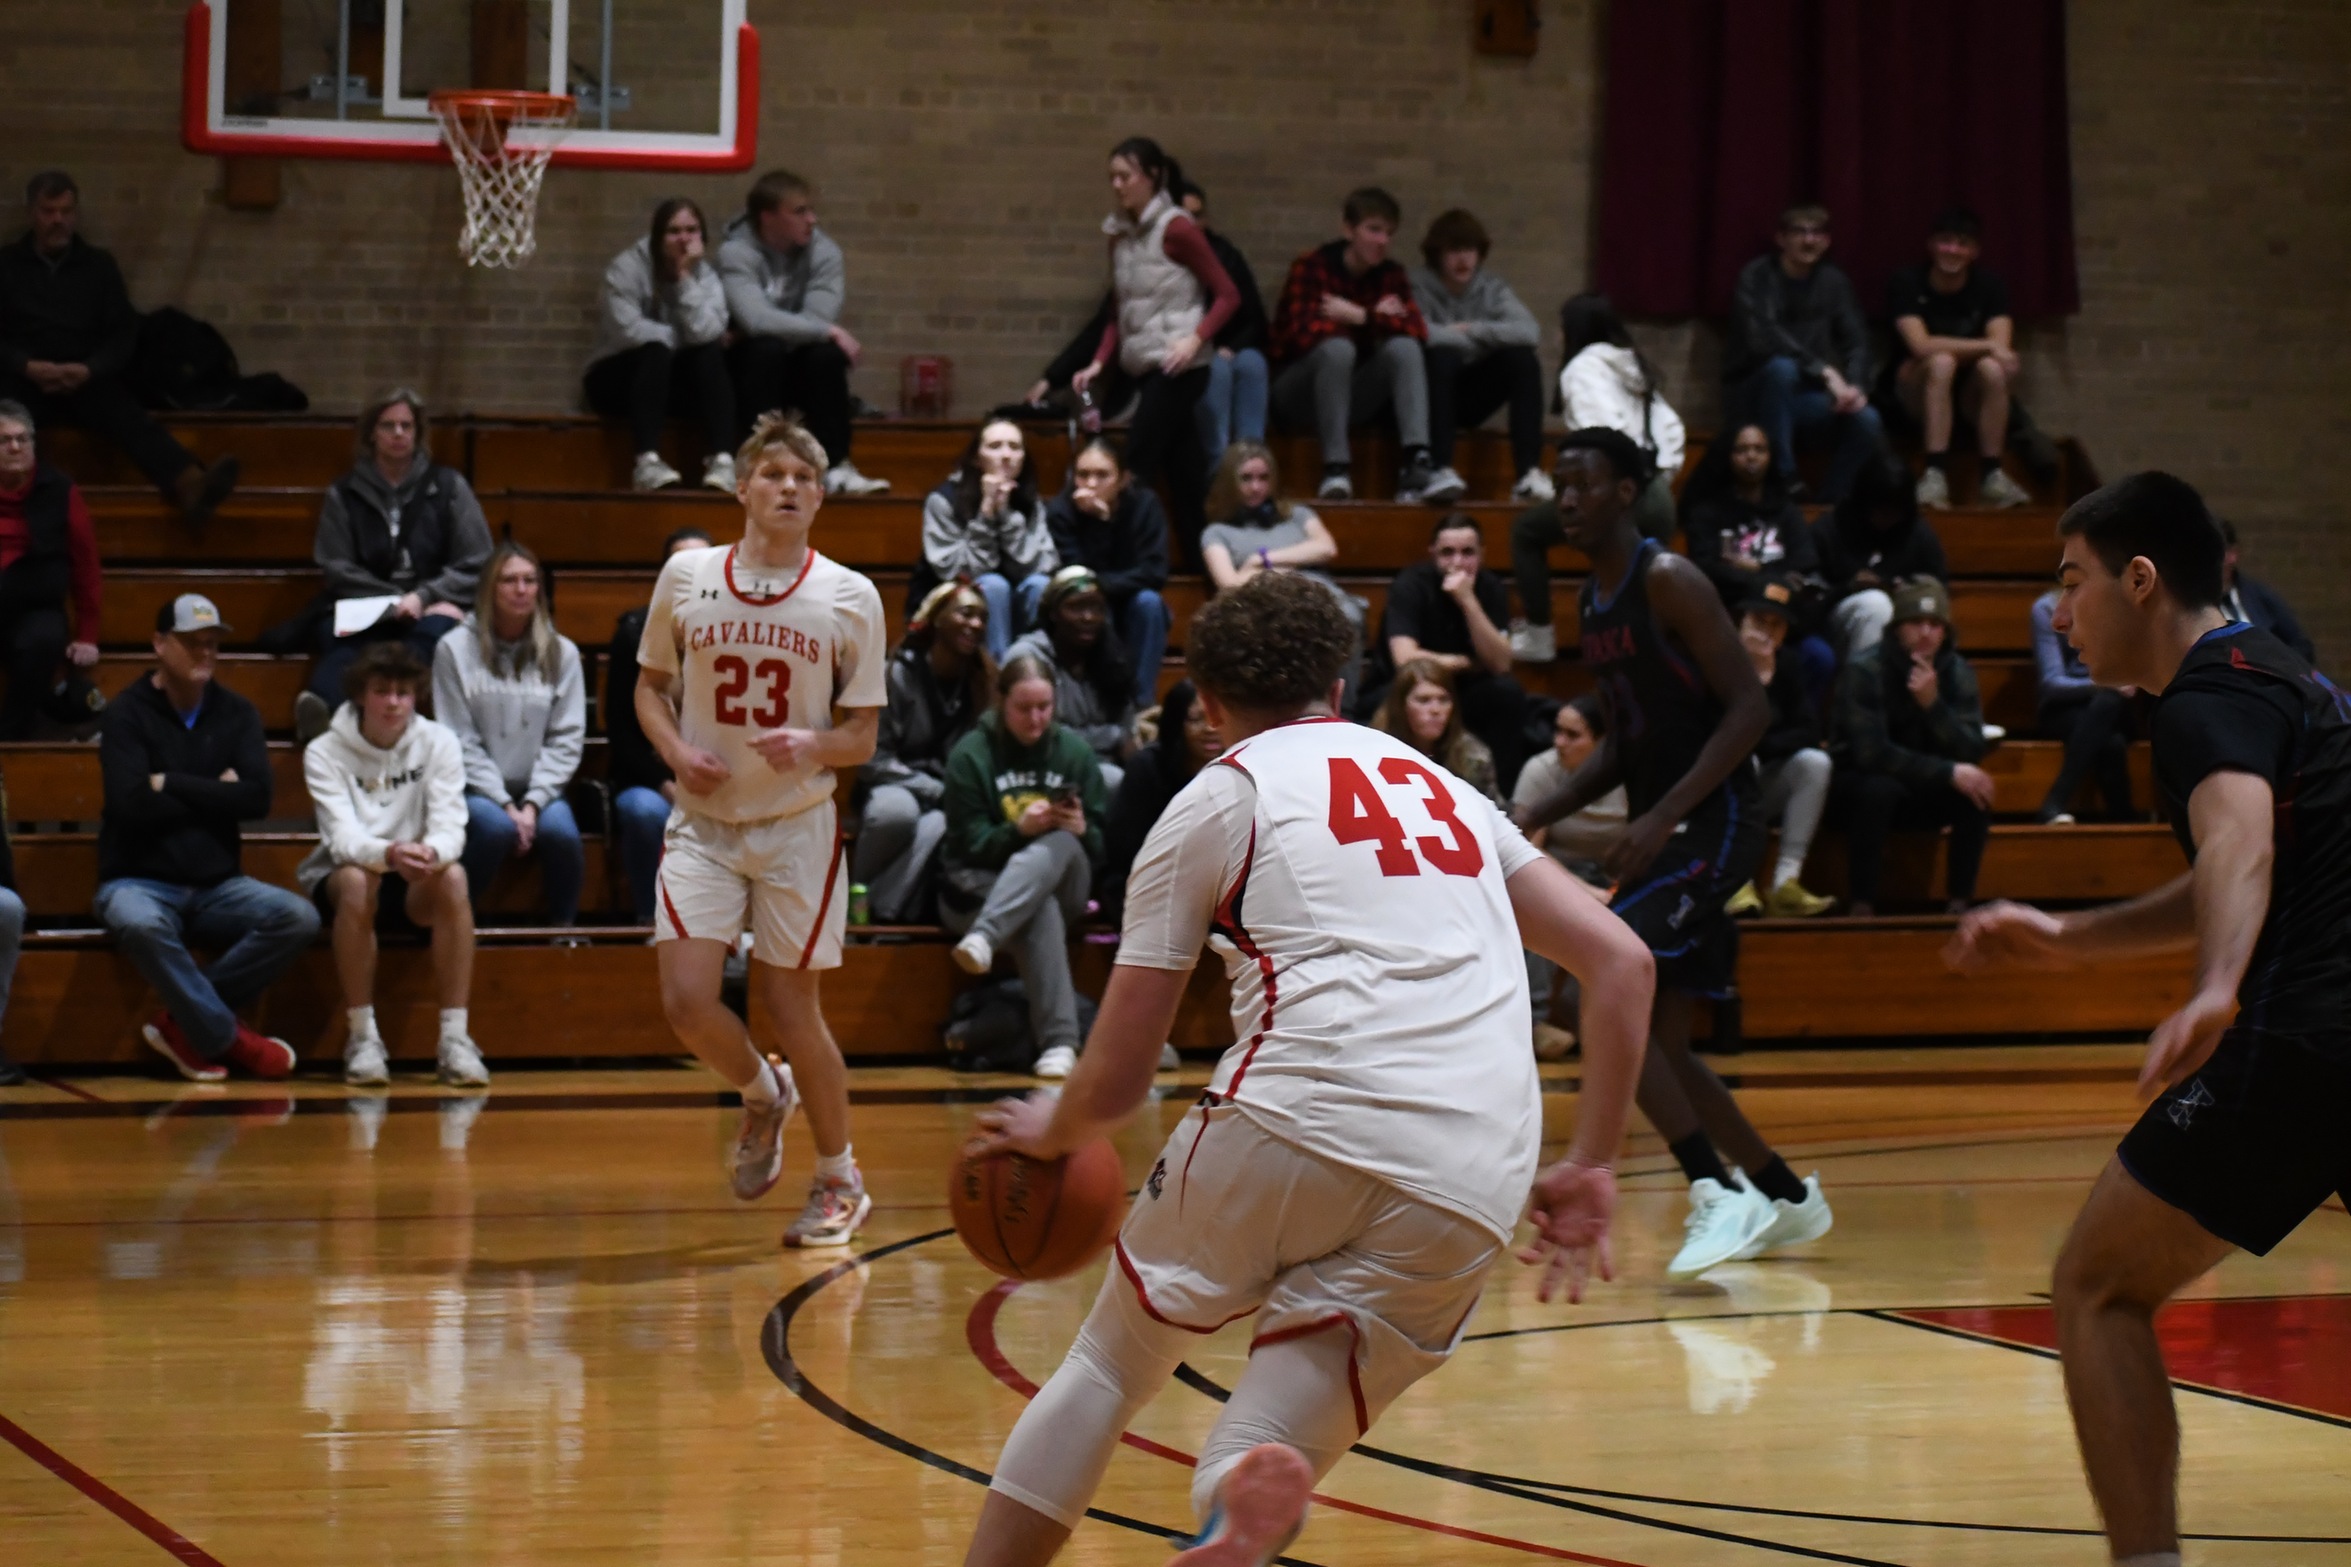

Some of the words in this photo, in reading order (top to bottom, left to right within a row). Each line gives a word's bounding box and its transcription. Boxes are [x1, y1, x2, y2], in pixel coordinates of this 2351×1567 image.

[691, 621, 820, 664] CAVALIERS
[713, 654, 791, 728] 23
[1328, 757, 1484, 878] 43
